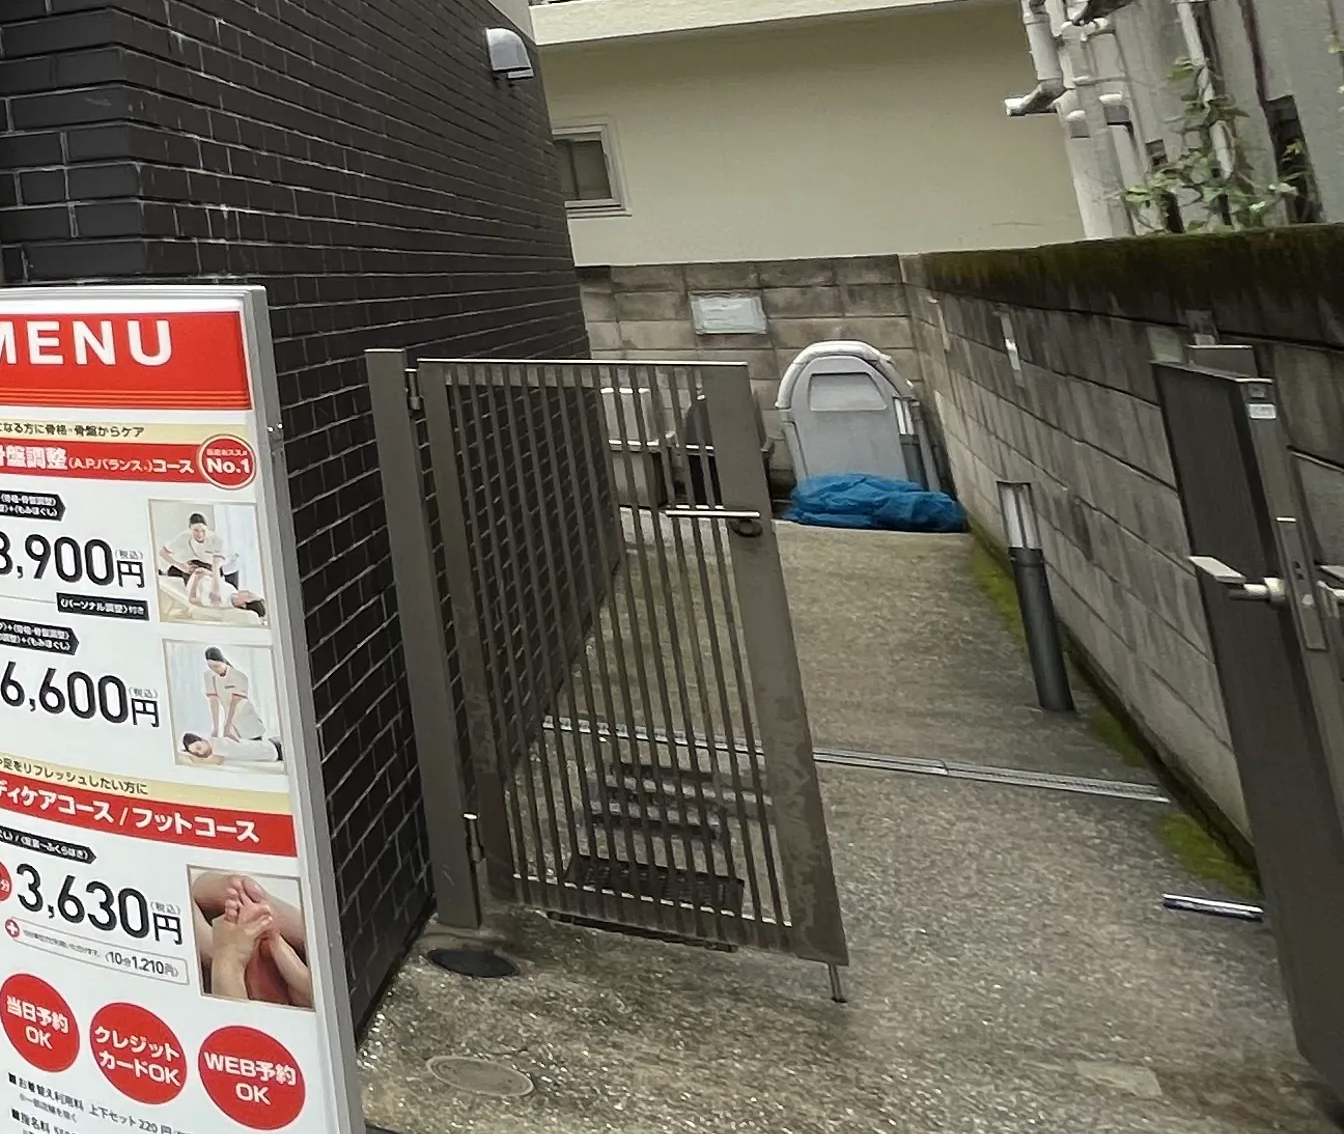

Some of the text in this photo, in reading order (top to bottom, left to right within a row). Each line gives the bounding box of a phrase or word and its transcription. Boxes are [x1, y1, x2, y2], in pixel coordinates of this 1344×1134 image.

[206, 457, 250, 474] No.1
[132, 807, 260, 843] フットコース
[6, 995, 70, 1034] 当日予約
[24, 1025, 54, 1050] OK
[94, 1025, 180, 1063] クレジット
[98, 1050, 181, 1087] カードOK
[203, 1051, 297, 1086] WEB予約
[234, 1082, 272, 1106] OK
[89, 1103, 137, 1128] 上下セット
